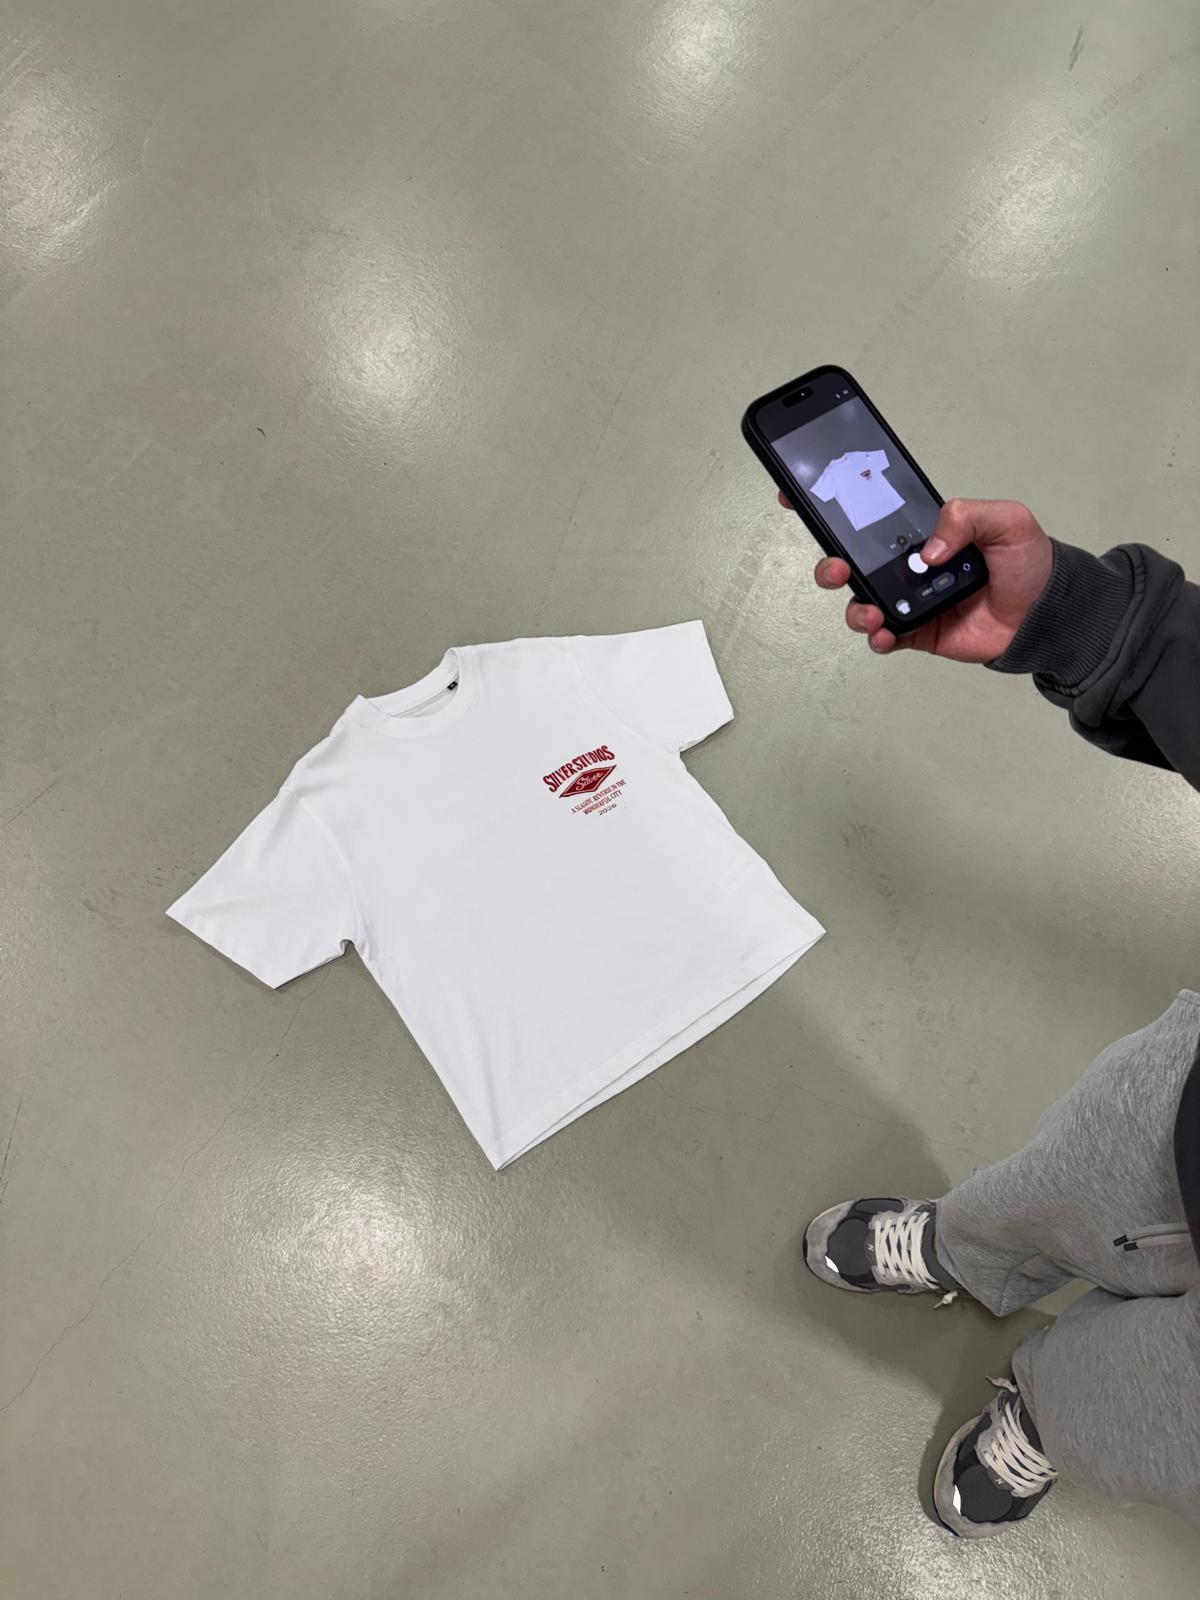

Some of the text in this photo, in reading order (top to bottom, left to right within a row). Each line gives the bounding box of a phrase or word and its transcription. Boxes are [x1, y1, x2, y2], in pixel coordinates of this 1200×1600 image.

[543, 745, 615, 792] SILVER STUDIOS
[610, 790, 623, 802] CITY
